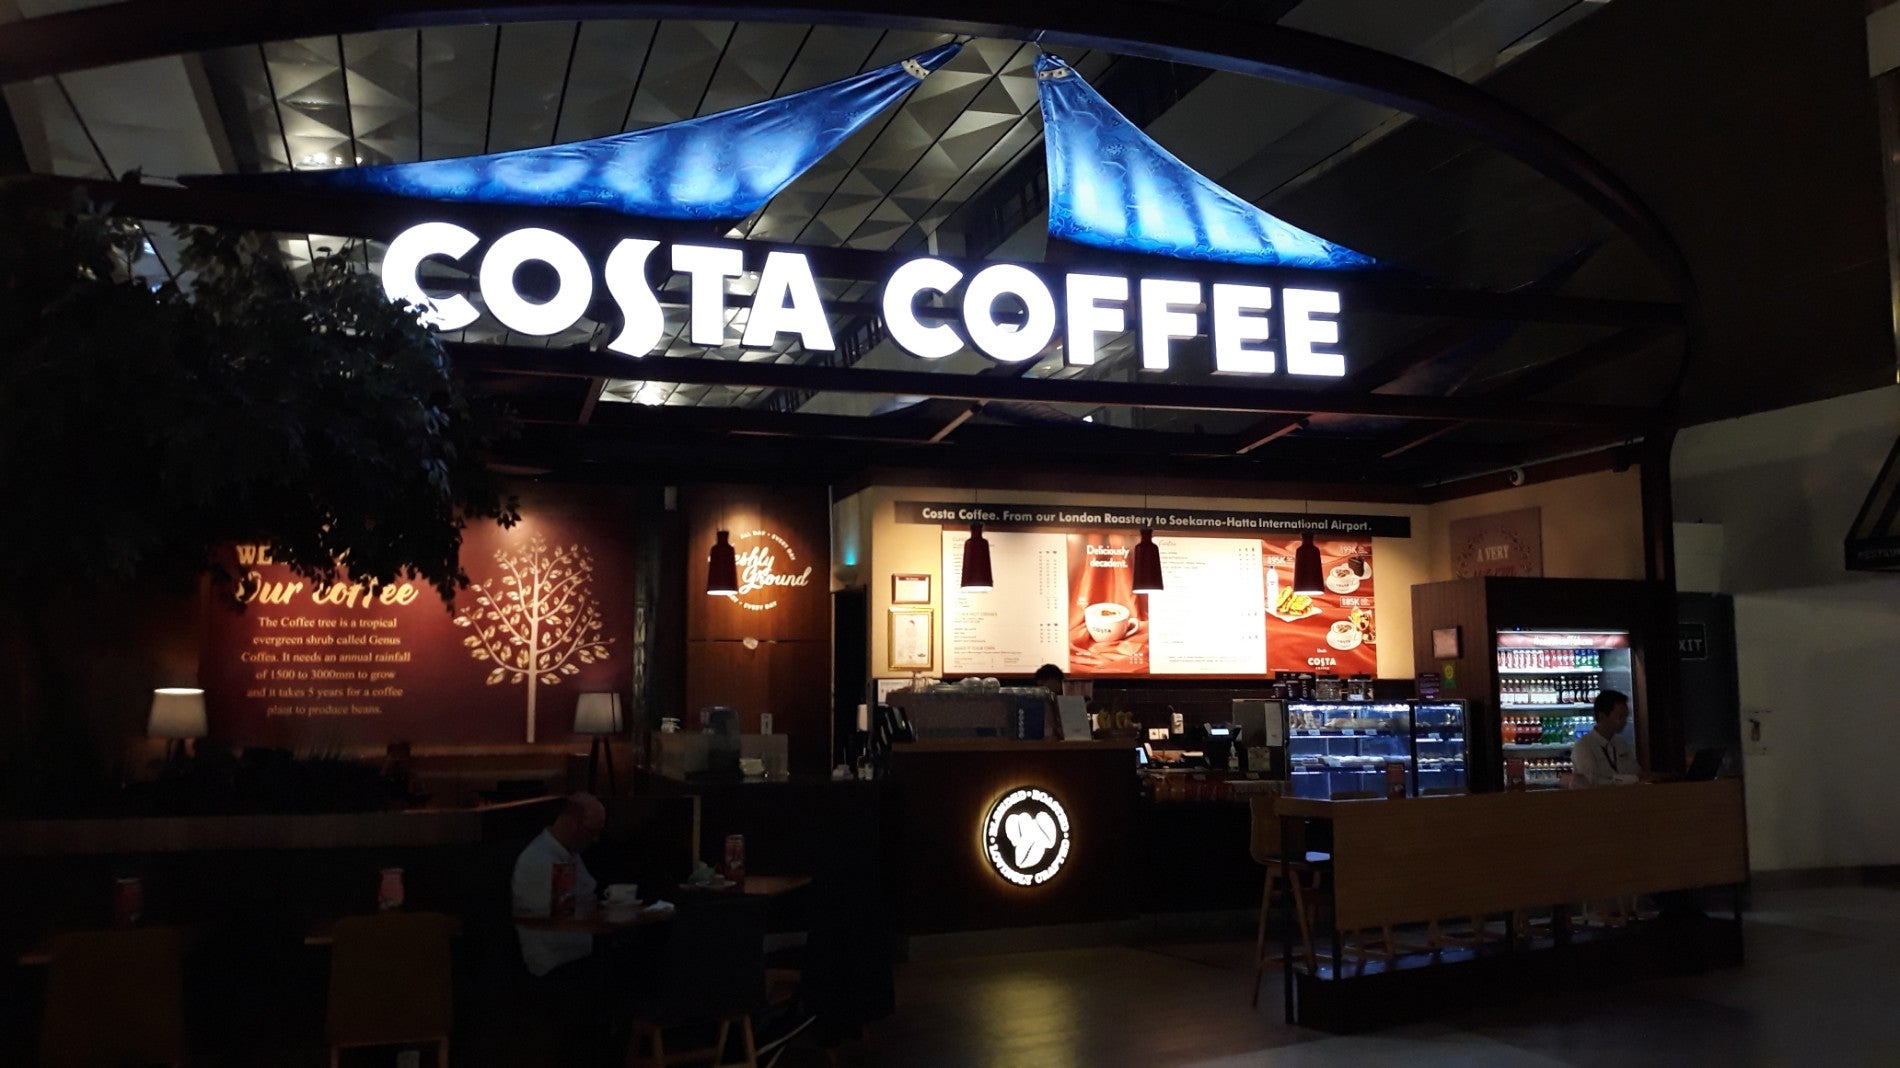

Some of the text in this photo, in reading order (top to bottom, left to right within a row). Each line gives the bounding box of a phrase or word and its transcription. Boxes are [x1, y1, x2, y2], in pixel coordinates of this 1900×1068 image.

[381, 221, 1346, 377] COSTA COFFEE
[922, 507, 1372, 532] Costa Coffee. From our London Roastery to Soekarno-Hatta International Airport.
[1086, 545, 1130, 558] Deliciously
[1485, 545, 1510, 561] VERY
[735, 546, 775, 573] eshly
[1089, 558, 1128, 568] decadent.
[739, 566, 812, 594] Ground
[258, 617, 398, 630] The Coffee tree is a tropical
[253, 634, 401, 647] evergreen shrub called Genus
[282, 652, 291, 662] It
[293, 652, 321, 662] needs
[324, 654, 336, 662] an
[339, 652, 372, 662] annual
[375, 651, 411, 662] rainfall
[1307, 657, 1337, 667] COSTA
[256, 669, 396, 683] of 1500 to 3000mm to grow
[247, 686, 266, 698] and
[269, 687, 276, 698] it
[279, 687, 305, 698] takes
[317, 688, 344, 700] years
[346, 686, 361, 698] for
[363, 689, 370, 698] a
[372, 686, 404, 698] coffee
[267, 704, 293, 716] plant
[295, 705, 306, 715] to
[308, 704, 348, 716] produce
